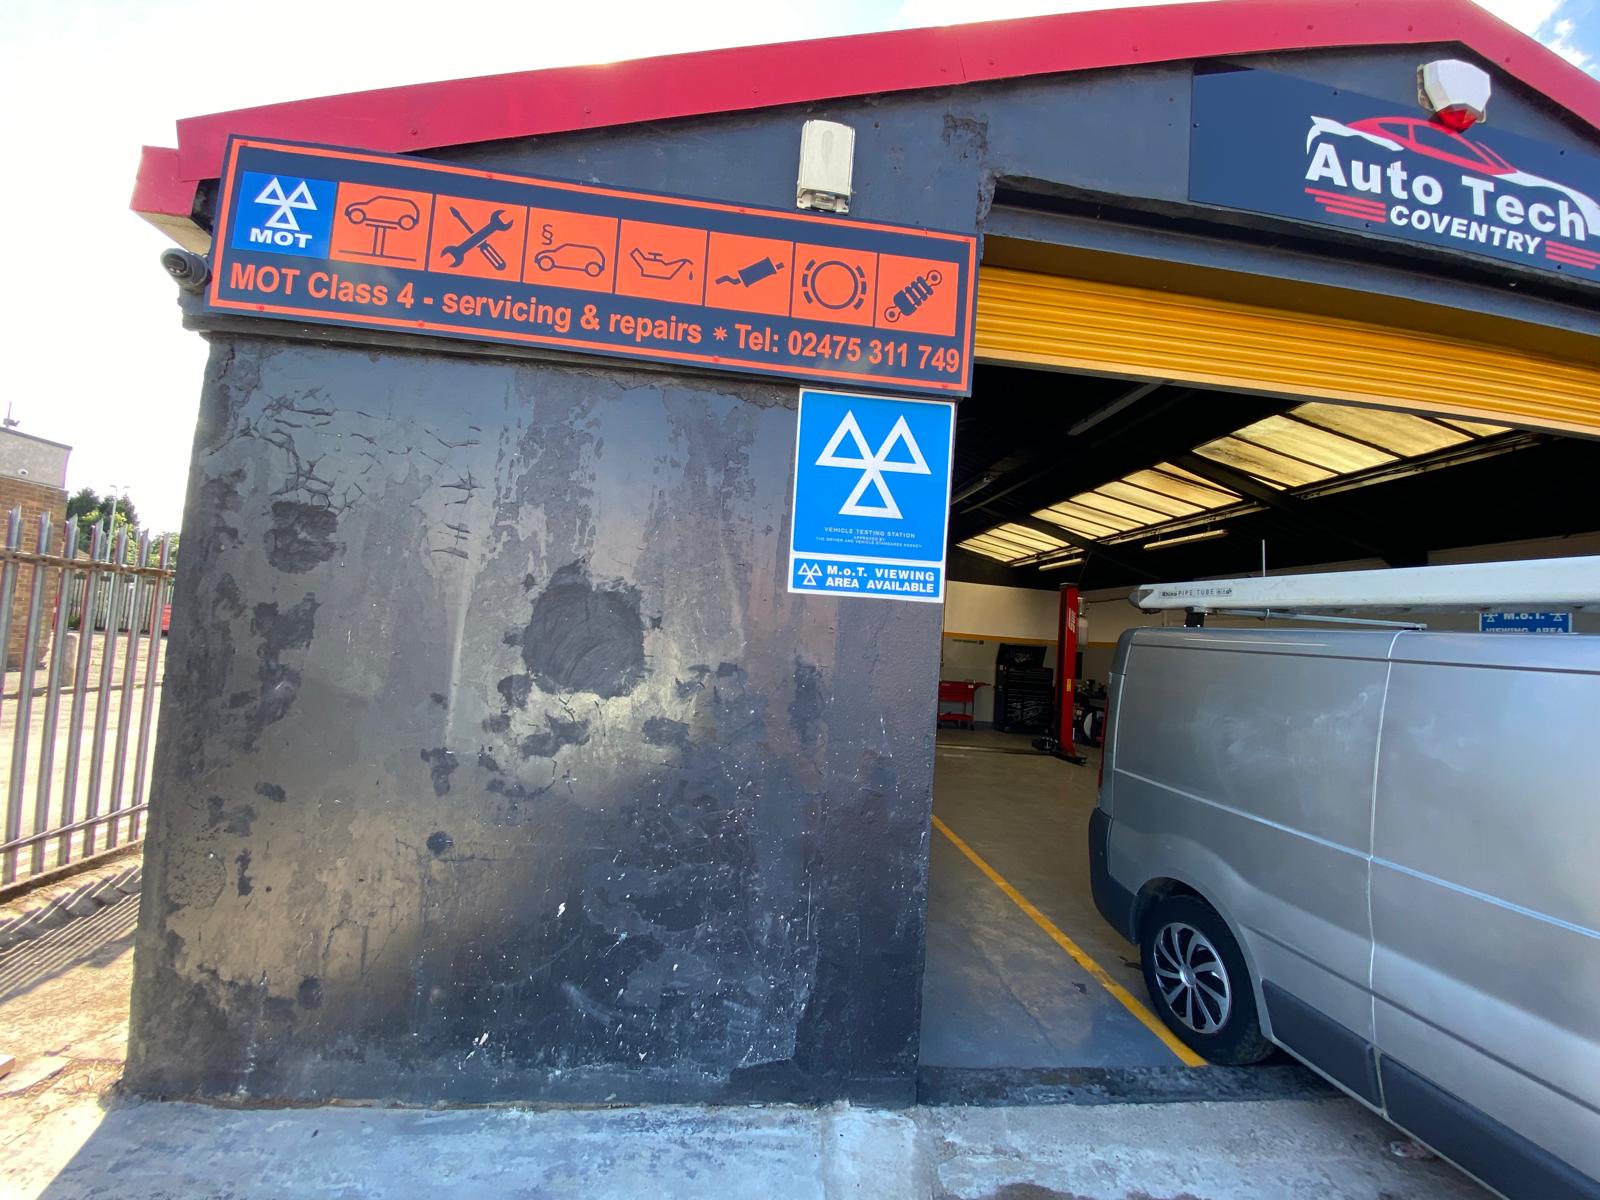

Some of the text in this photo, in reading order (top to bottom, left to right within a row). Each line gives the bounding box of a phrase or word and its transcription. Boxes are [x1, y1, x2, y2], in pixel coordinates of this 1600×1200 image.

[1304, 142, 1585, 241] Auto Tech
[249, 228, 312, 249] MOT
[1390, 205, 1542, 255] COVENTRY
[230, 262, 300, 295] MOT
[307, 271, 388, 306] Class
[397, 282, 415, 308] 4
[442, 291, 572, 333] servicing
[580, 304, 600, 330] &
[609, 312, 702, 344] repairs
[735, 323, 779, 353] Tel:
[787, 330, 862, 361] 02475
[868, 339, 908, 367] 311
[918, 345, 960, 373] 749
[887, 531, 916, 539] STATION
[825, 577, 934, 593] AREA AVAILABLE
[875, 568, 935, 581] VIEWING
